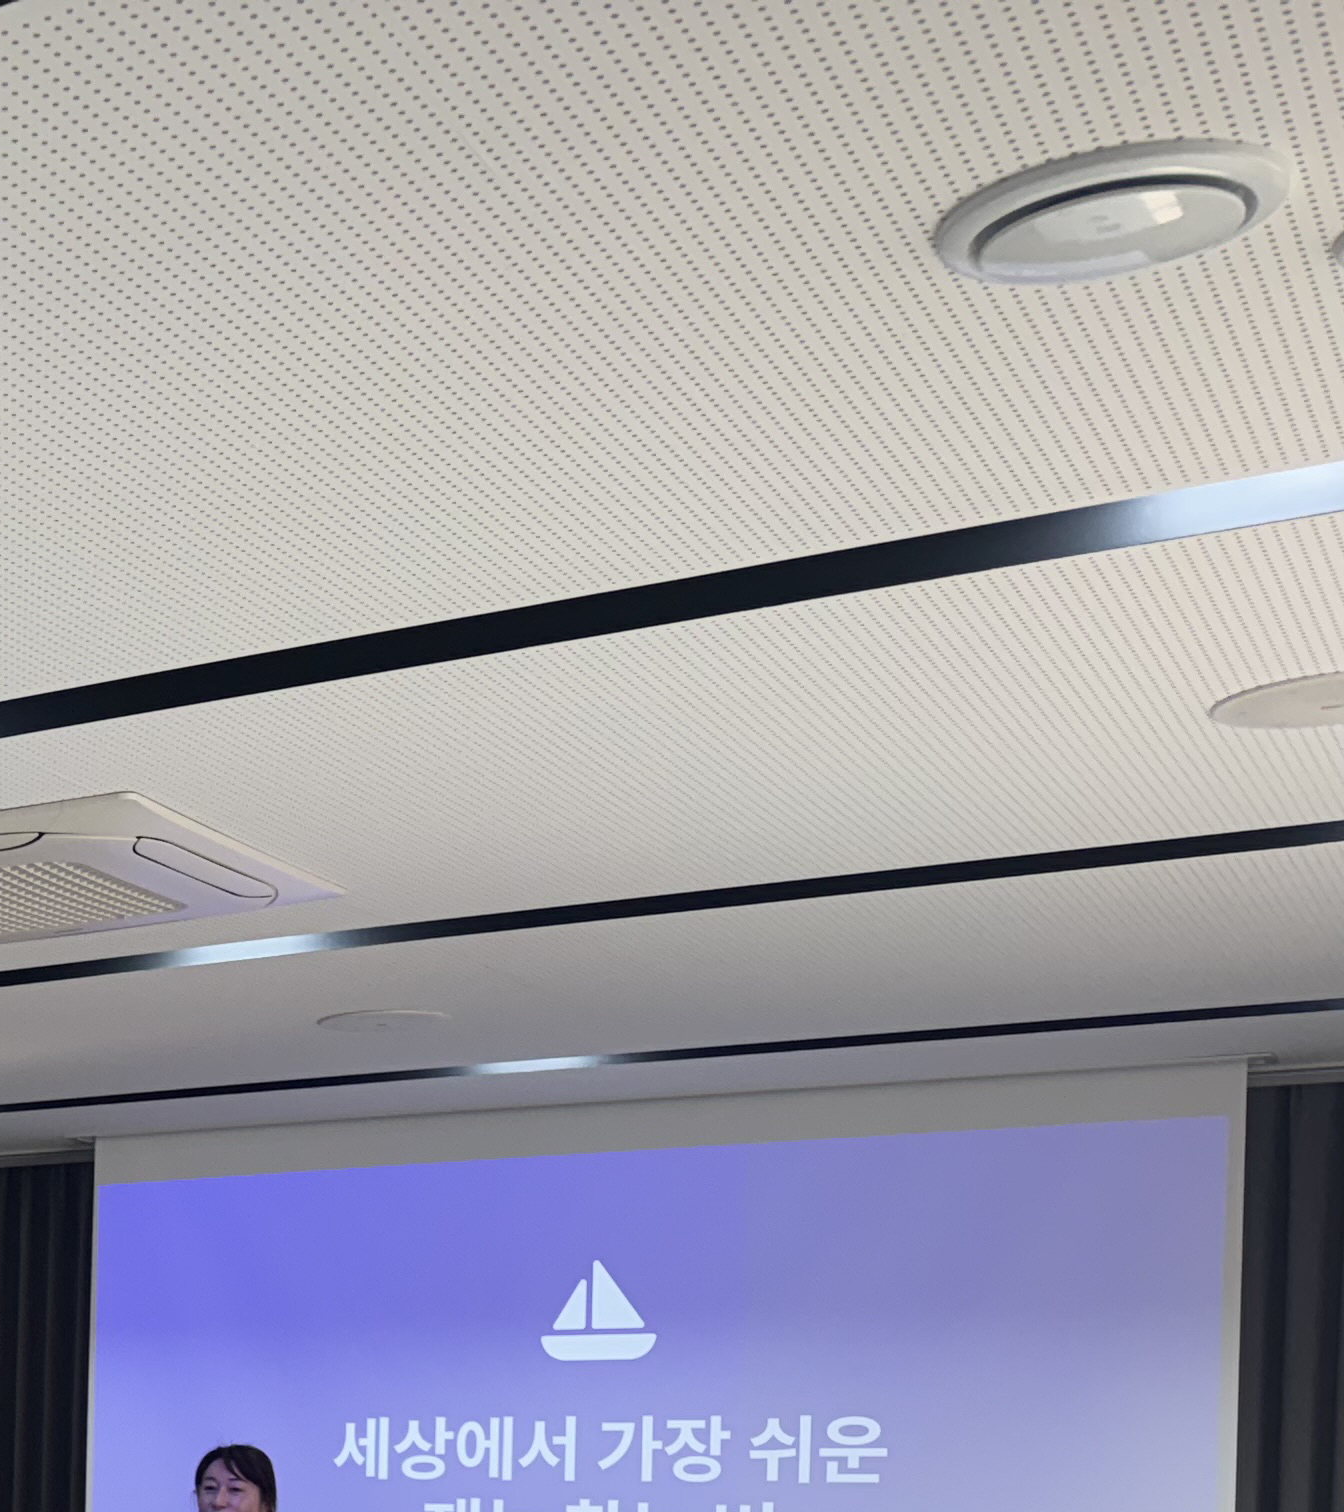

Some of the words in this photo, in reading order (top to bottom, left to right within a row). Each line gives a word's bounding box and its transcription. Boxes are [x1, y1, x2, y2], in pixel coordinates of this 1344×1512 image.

[332, 1415, 577, 1482] 세상에서
[597, 1415, 732, 1484] 가장
[748, 1414, 889, 1485] 쉬운
